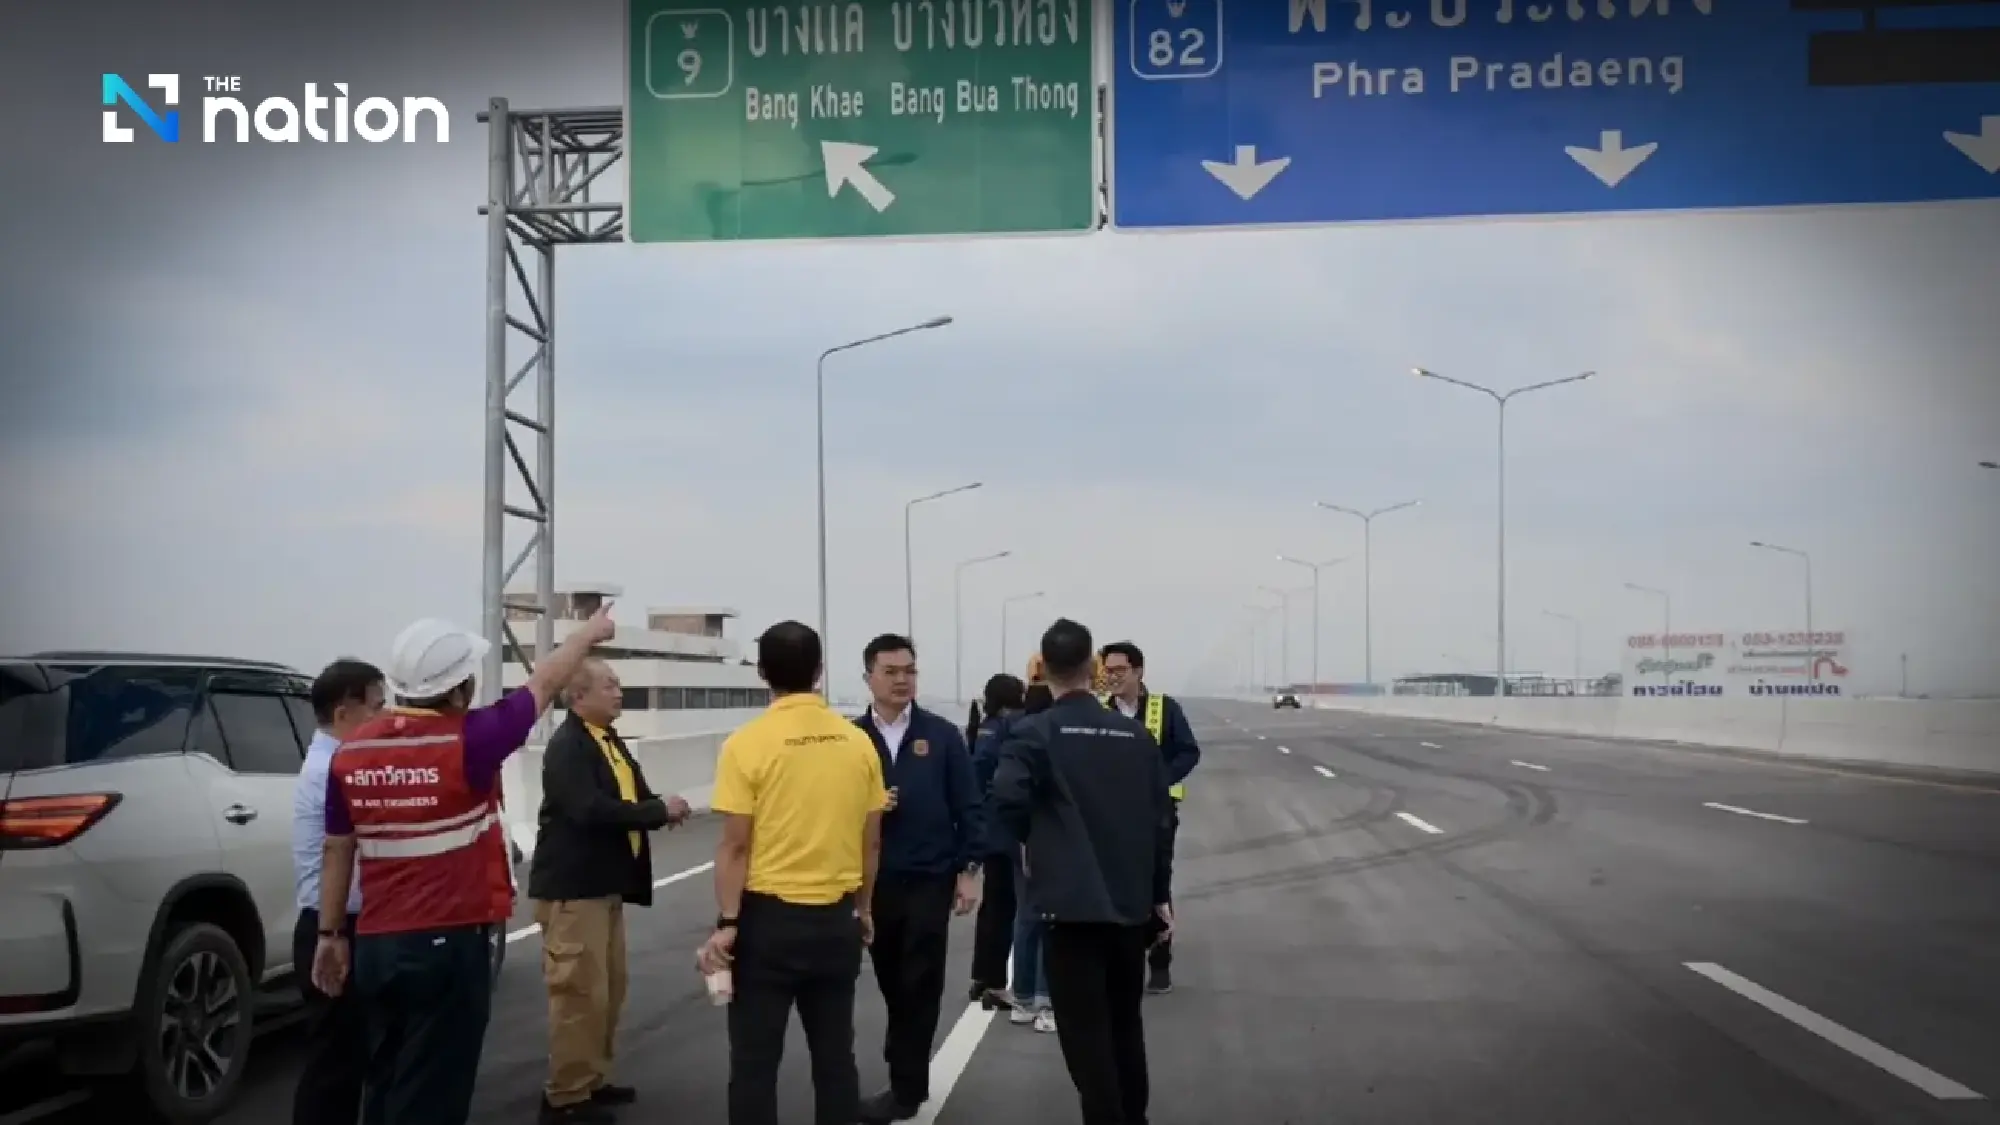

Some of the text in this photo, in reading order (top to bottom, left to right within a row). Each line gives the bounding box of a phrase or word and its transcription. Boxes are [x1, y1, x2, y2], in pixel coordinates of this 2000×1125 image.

[746, 2, 864, 57] บางแค
[1148, 29, 1206, 67] 82
[677, 49, 702, 85] 9
[1313, 53, 1684, 98] Phra Pradaeng
[745, 76, 1079, 129] Bang Khae Bang Bua Thong
